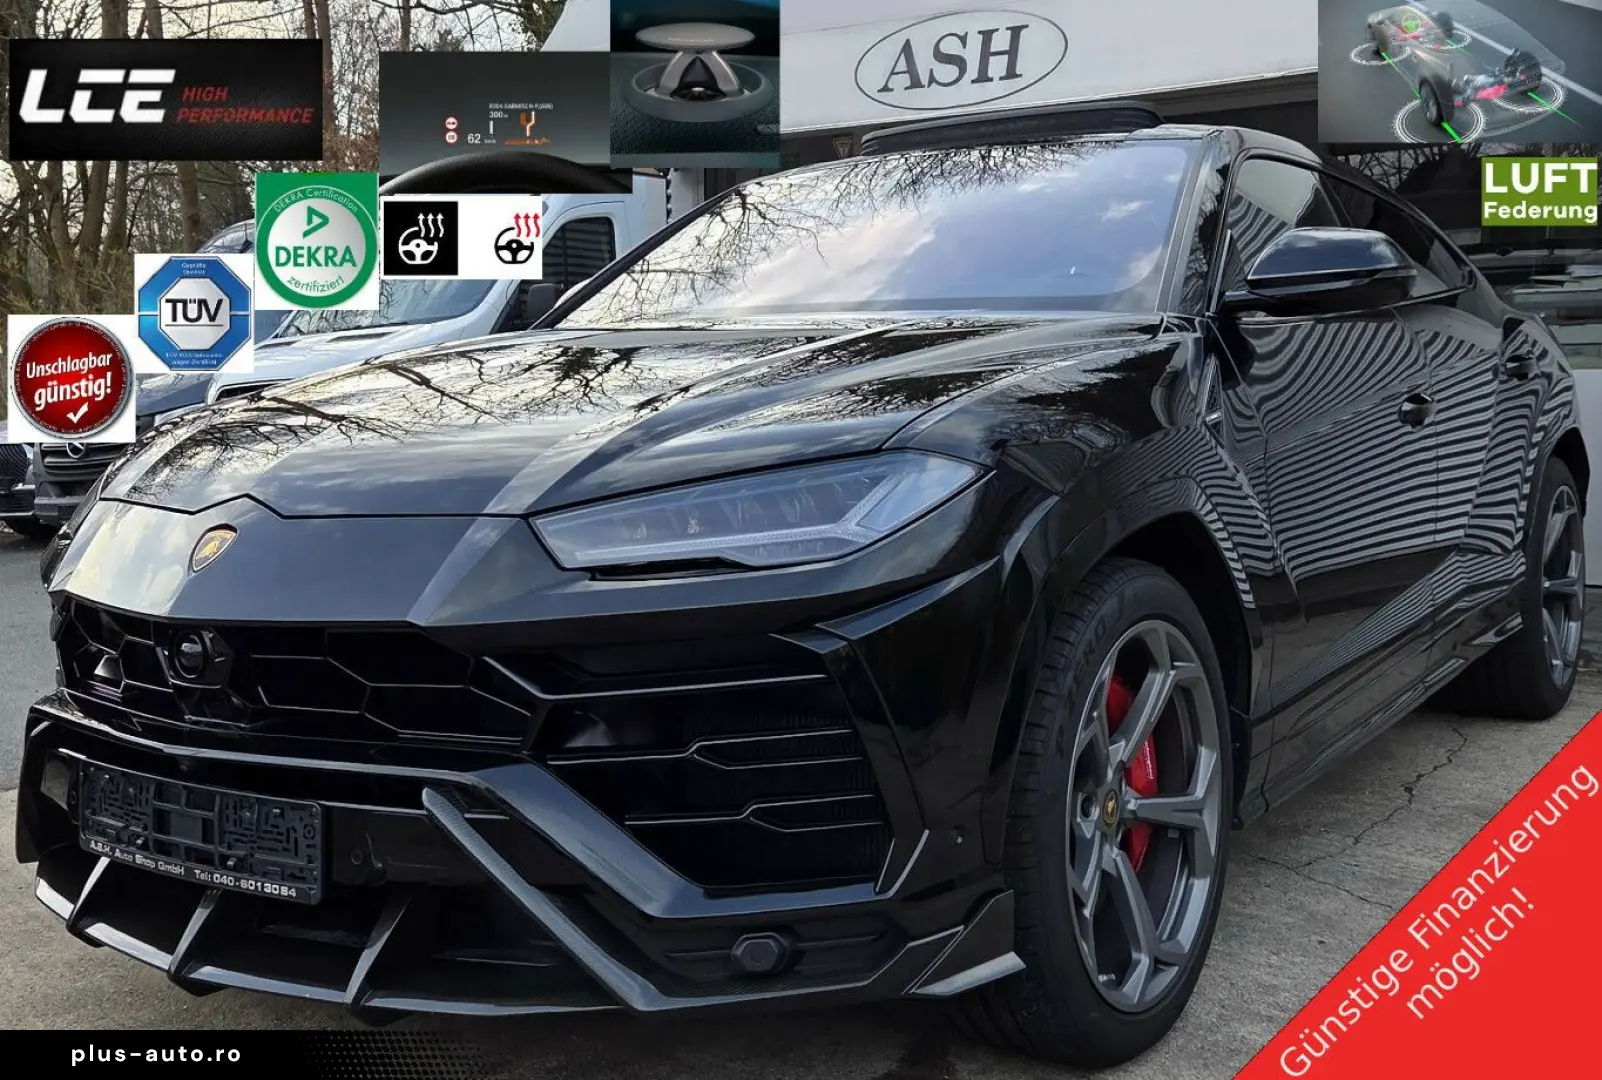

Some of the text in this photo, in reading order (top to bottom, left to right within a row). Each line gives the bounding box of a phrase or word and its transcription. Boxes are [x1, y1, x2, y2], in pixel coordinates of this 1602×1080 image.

[877, 24, 1029, 93] ASH
[114, 848, 134, 862] Auto
[135, 854, 156, 869] Shop
[157, 861, 185, 876] GmbH
[194, 869, 211, 883] Tel:
